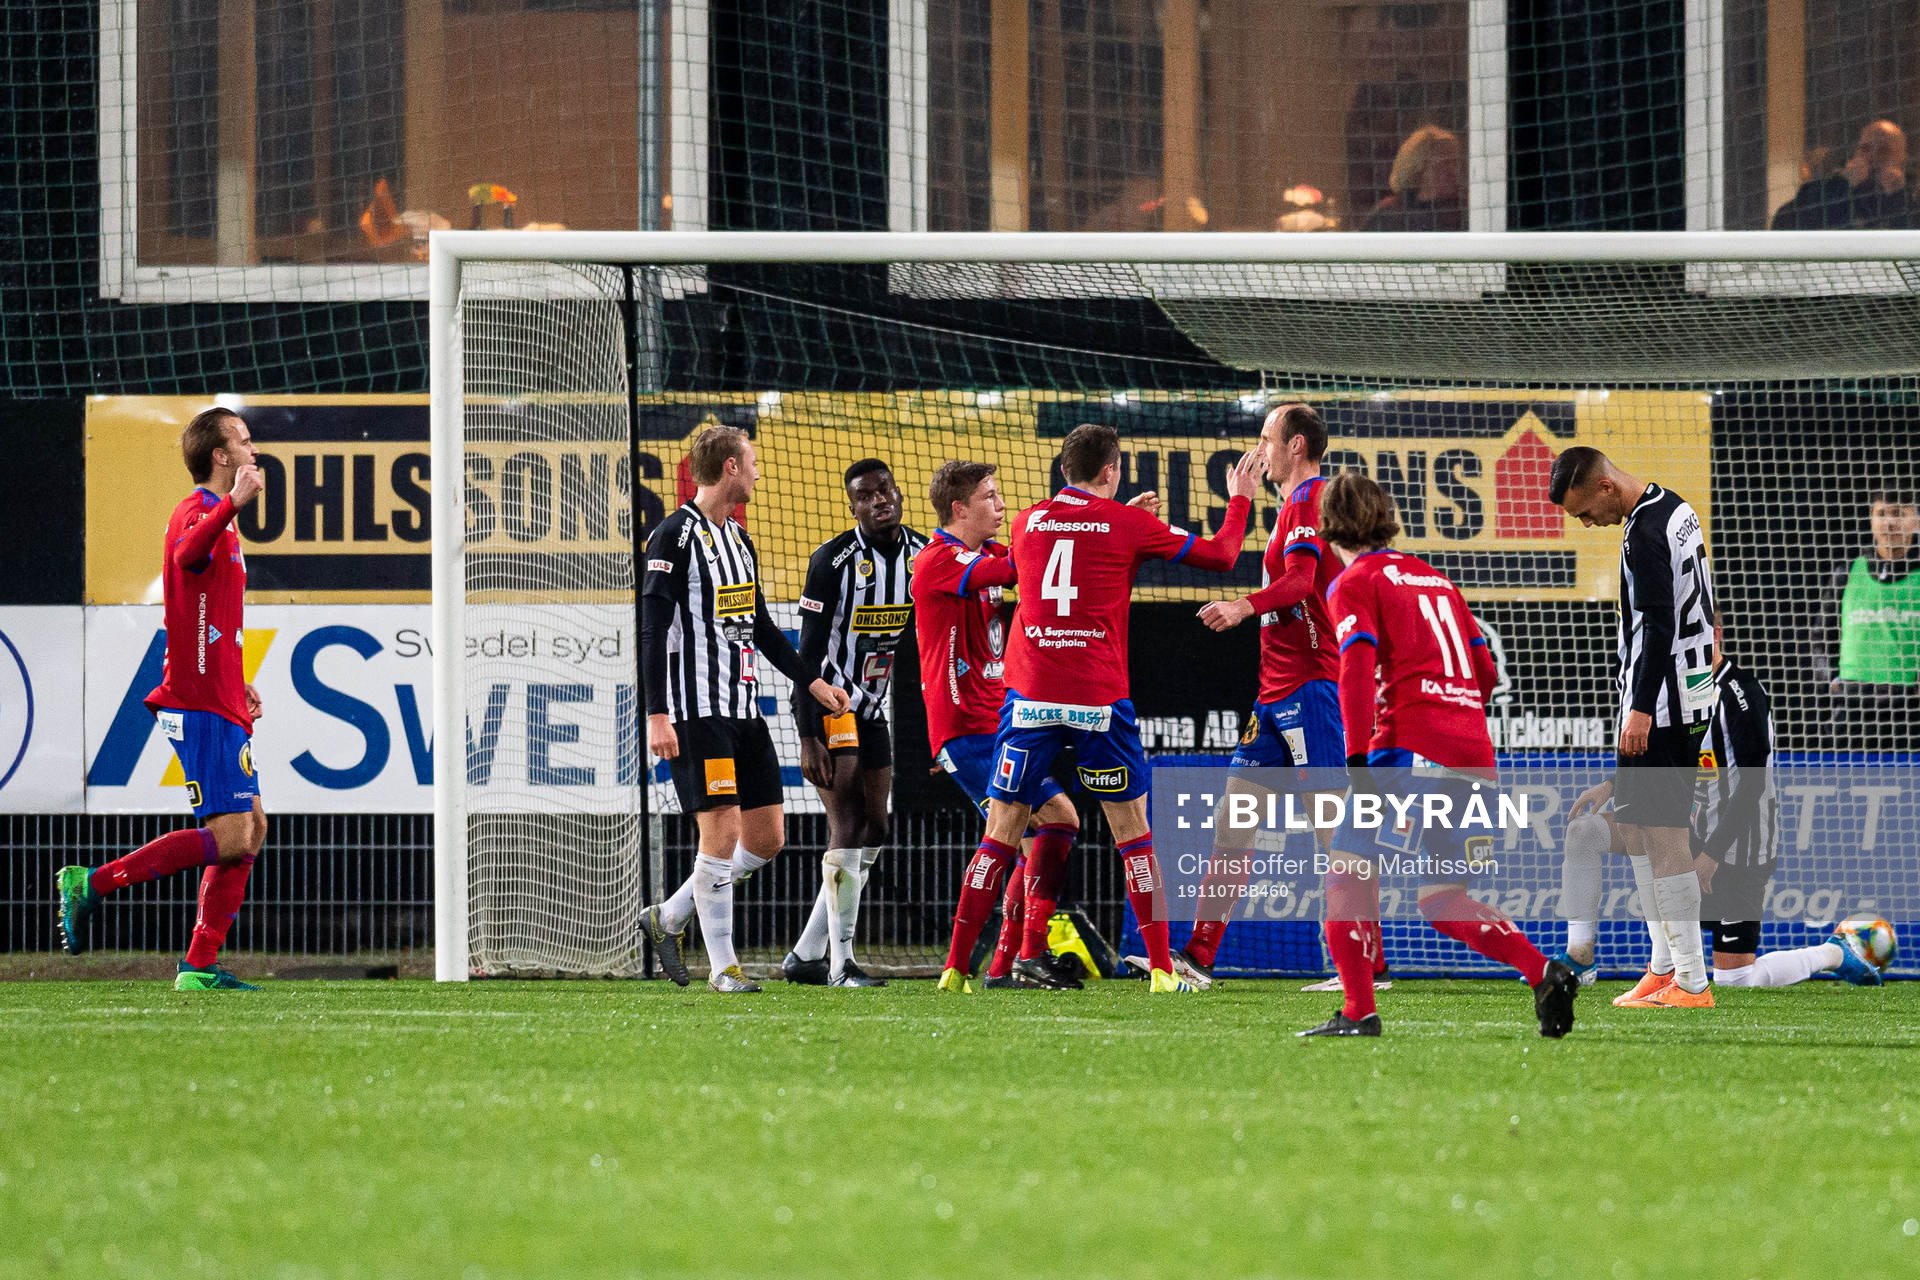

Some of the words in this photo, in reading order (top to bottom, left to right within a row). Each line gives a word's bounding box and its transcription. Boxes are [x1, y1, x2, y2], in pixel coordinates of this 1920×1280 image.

[1041, 539, 1078, 617] 4
[856, 612, 907, 625] OHLSSONS
[1044, 627, 1106, 639] Supermarket
[552, 629, 622, 665] syd
[1038, 638, 1087, 649] Borgholm
[1418, 594, 1473, 680] 11
[1203, 710, 1239, 748] AB
